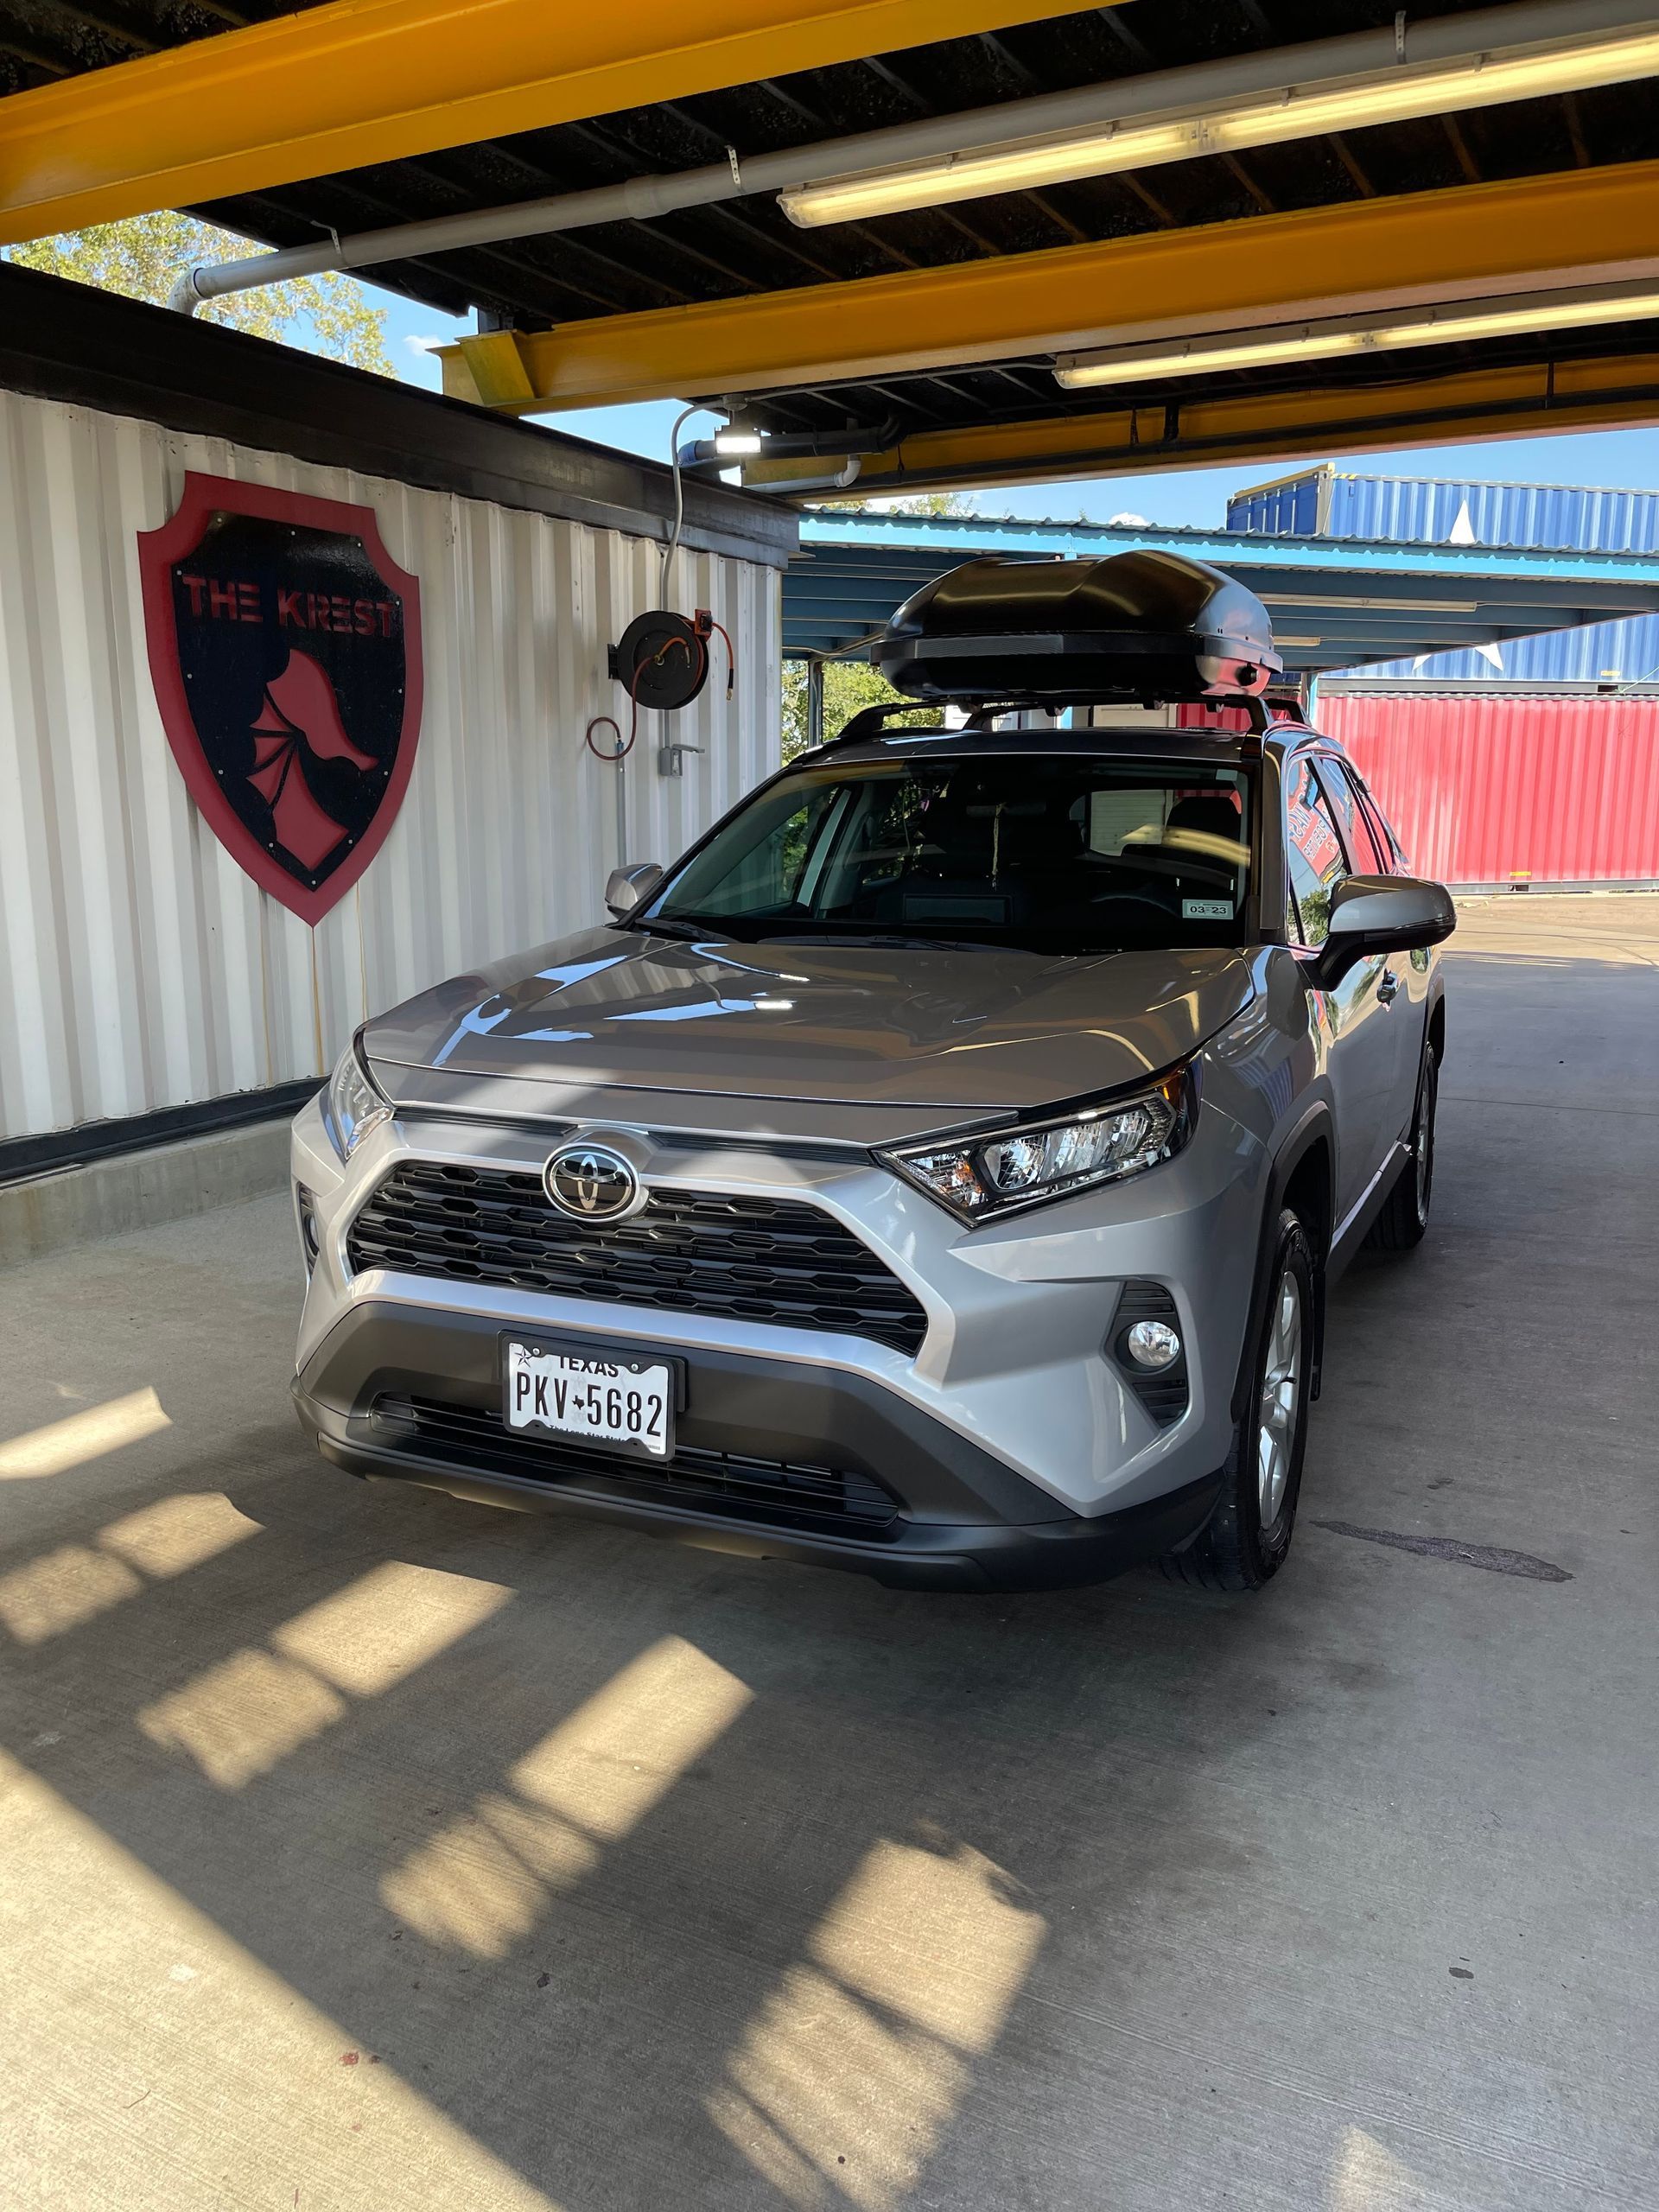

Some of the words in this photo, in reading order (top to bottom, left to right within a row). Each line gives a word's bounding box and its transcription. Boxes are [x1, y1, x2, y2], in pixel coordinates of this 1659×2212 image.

[182, 574, 264, 623] THE
[277, 588, 395, 637] KREST
[560, 1356, 619, 1378] TEXAS
